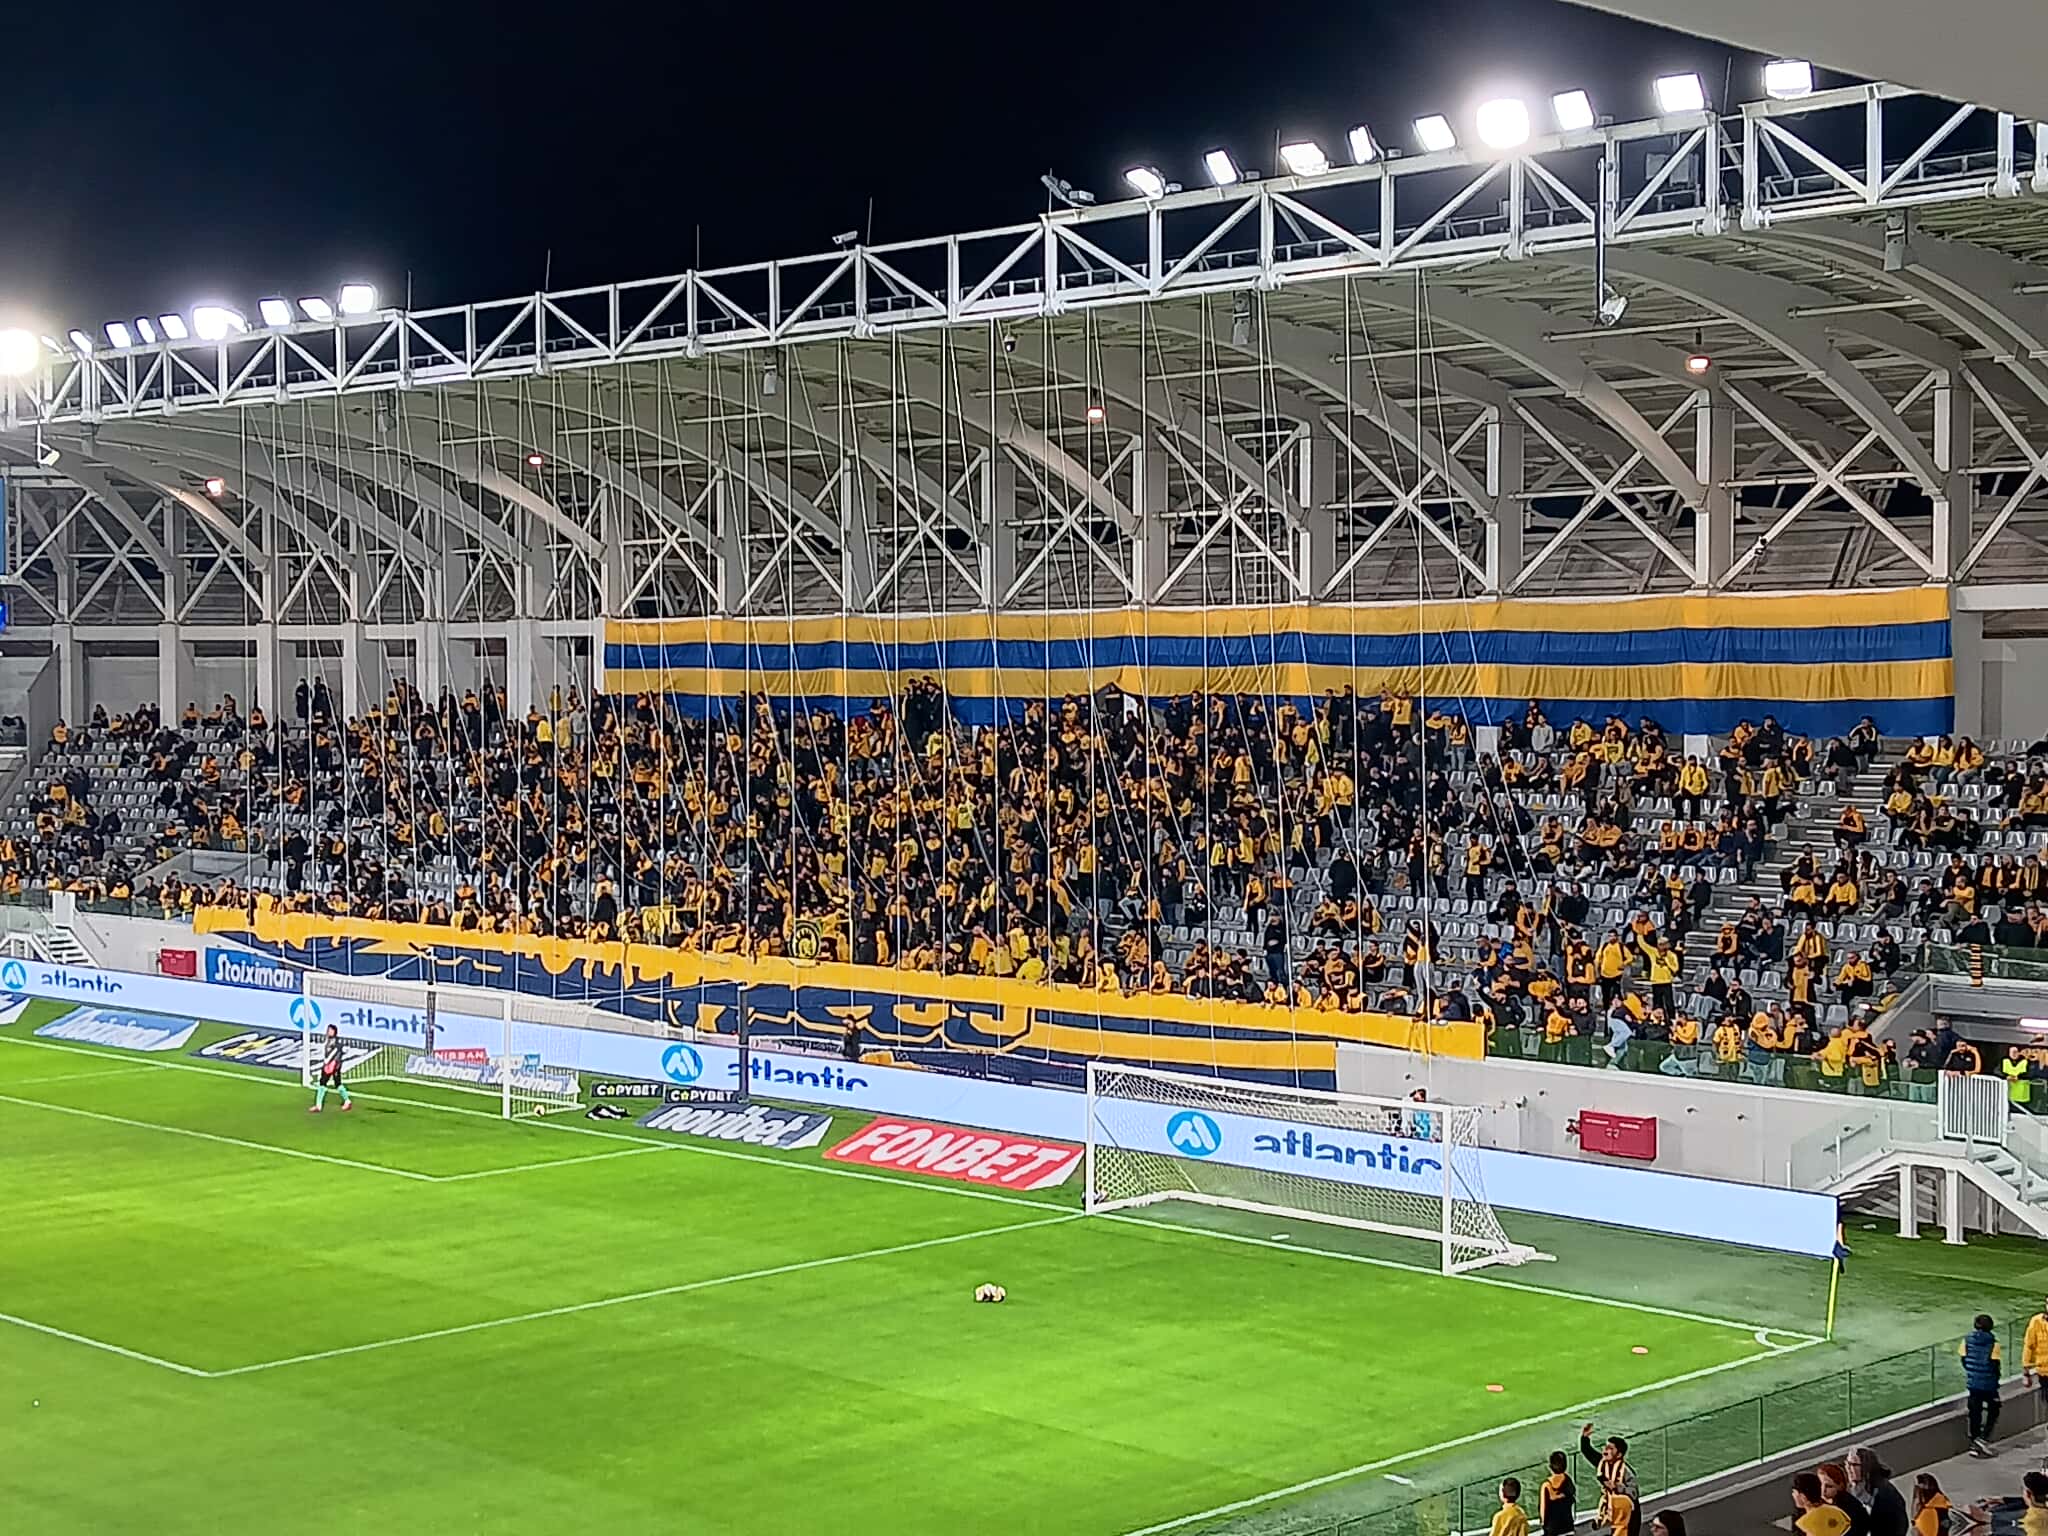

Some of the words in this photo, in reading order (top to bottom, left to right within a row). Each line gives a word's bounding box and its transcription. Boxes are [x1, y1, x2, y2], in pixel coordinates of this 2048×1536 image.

[215, 953, 293, 989] Stoiximan
[646, 1104, 808, 1146] novibet
[836, 1124, 1071, 1182] FONBET
[1254, 1129, 1442, 1175] atlantic
